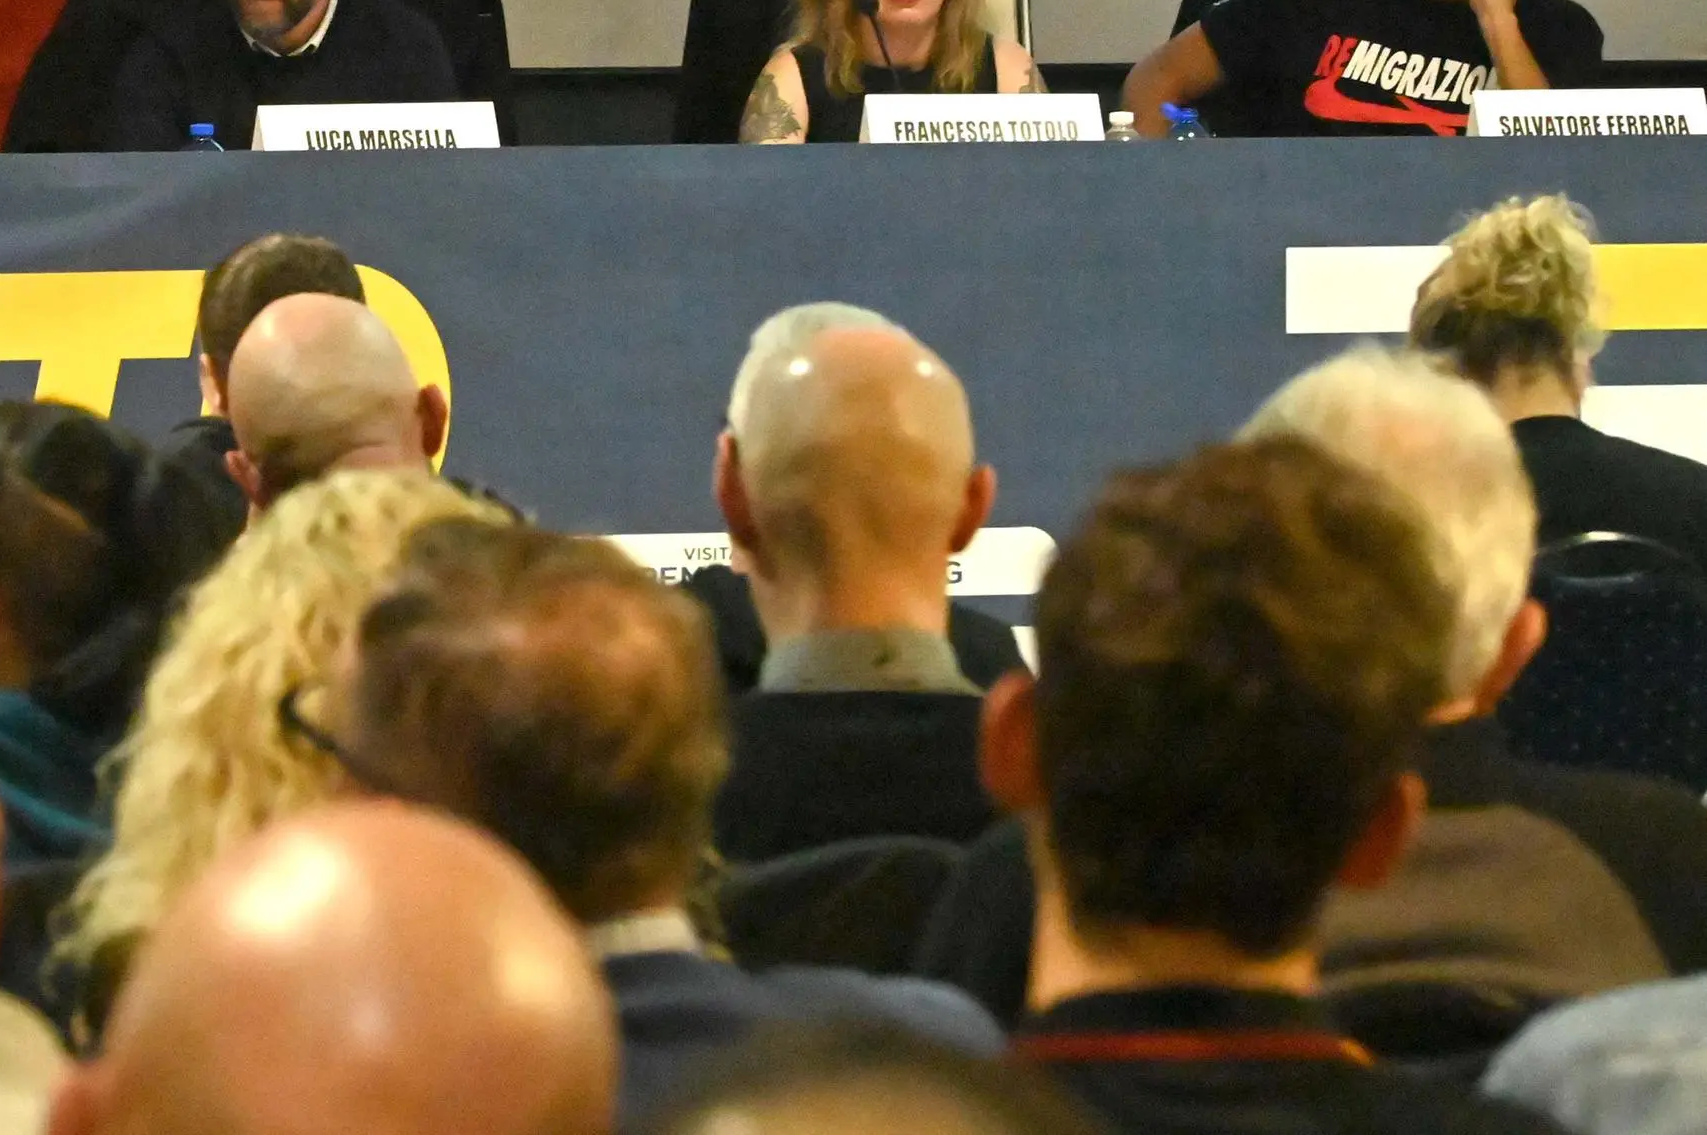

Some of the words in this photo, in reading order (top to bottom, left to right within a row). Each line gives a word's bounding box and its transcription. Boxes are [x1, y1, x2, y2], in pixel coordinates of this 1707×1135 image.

[895, 121, 1004, 142] FRANCESCA
[1010, 121, 1079, 141] TOTOLO
[1499, 115, 1602, 136] SALVATORE
[1606, 114, 1689, 135] FERRARA
[306, 130, 354, 151] LUCA
[360, 129, 458, 150] MARSELLA
